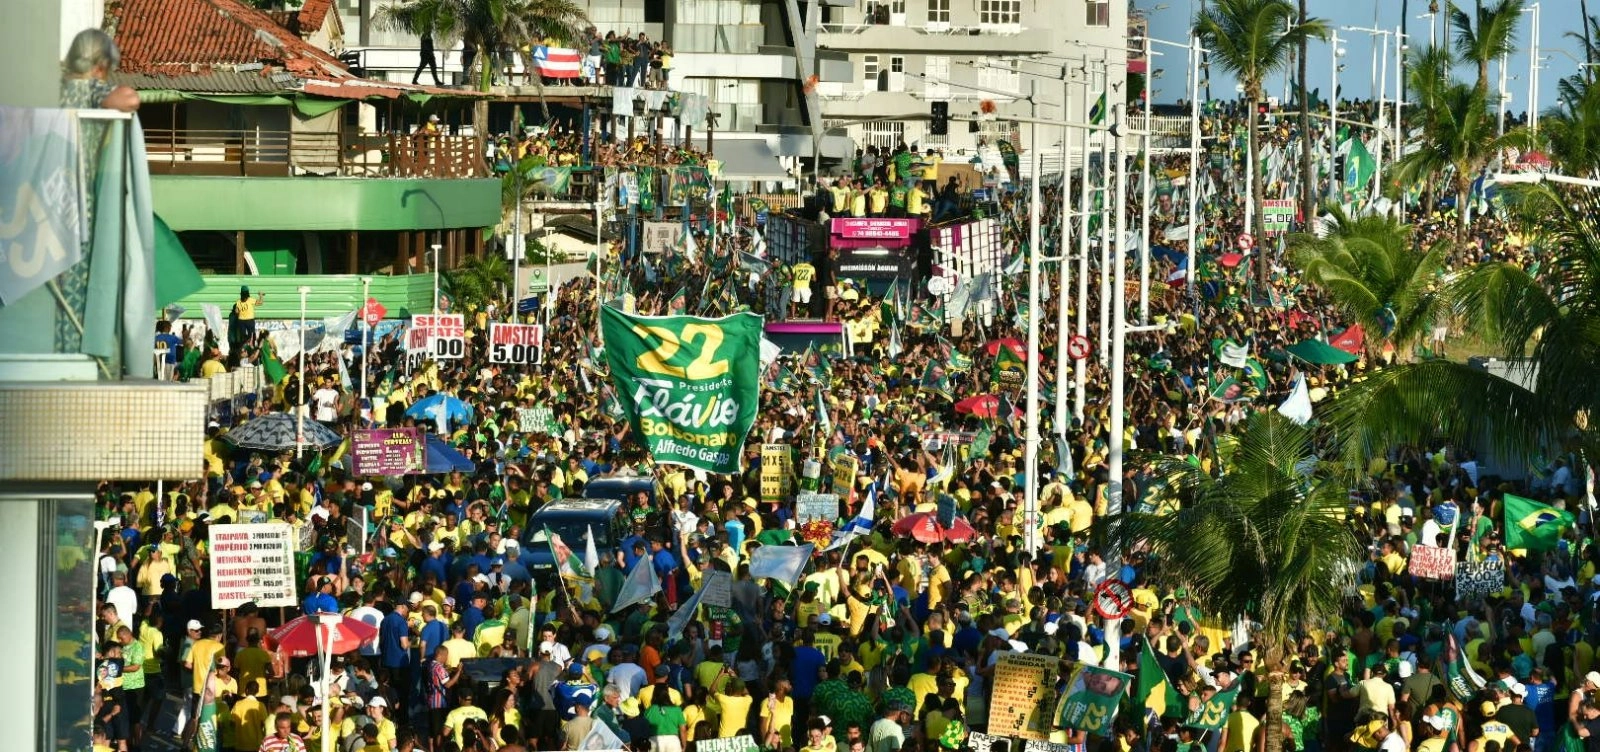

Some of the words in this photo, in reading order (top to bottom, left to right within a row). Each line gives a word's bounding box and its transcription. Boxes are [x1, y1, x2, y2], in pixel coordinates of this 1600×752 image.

[416, 317, 463, 327] SKOL
[428, 327, 464, 337] EATS
[493, 325, 539, 345] AMSTEL
[493, 344, 539, 364] 5.00
[632, 323, 729, 380] 22
[631, 376, 739, 428] Flávio
[640, 417, 737, 447] Bolsonaro
[655, 439, 697, 458] Alfredo
[698, 447, 730, 465] Gaspa
[215, 532, 249, 540] ITAIPAVA
[214, 543, 248, 551] IMPÉRIO
[1412, 546, 1450, 557] AMSTEL
[216, 555, 252, 564] HEINEKEN
[217, 567, 252, 577] HEINEKEN
[1458, 560, 1503, 574] HEINEKEN
[218, 592, 247, 600] AMSTEL
[1080, 702, 1107, 730] 22
